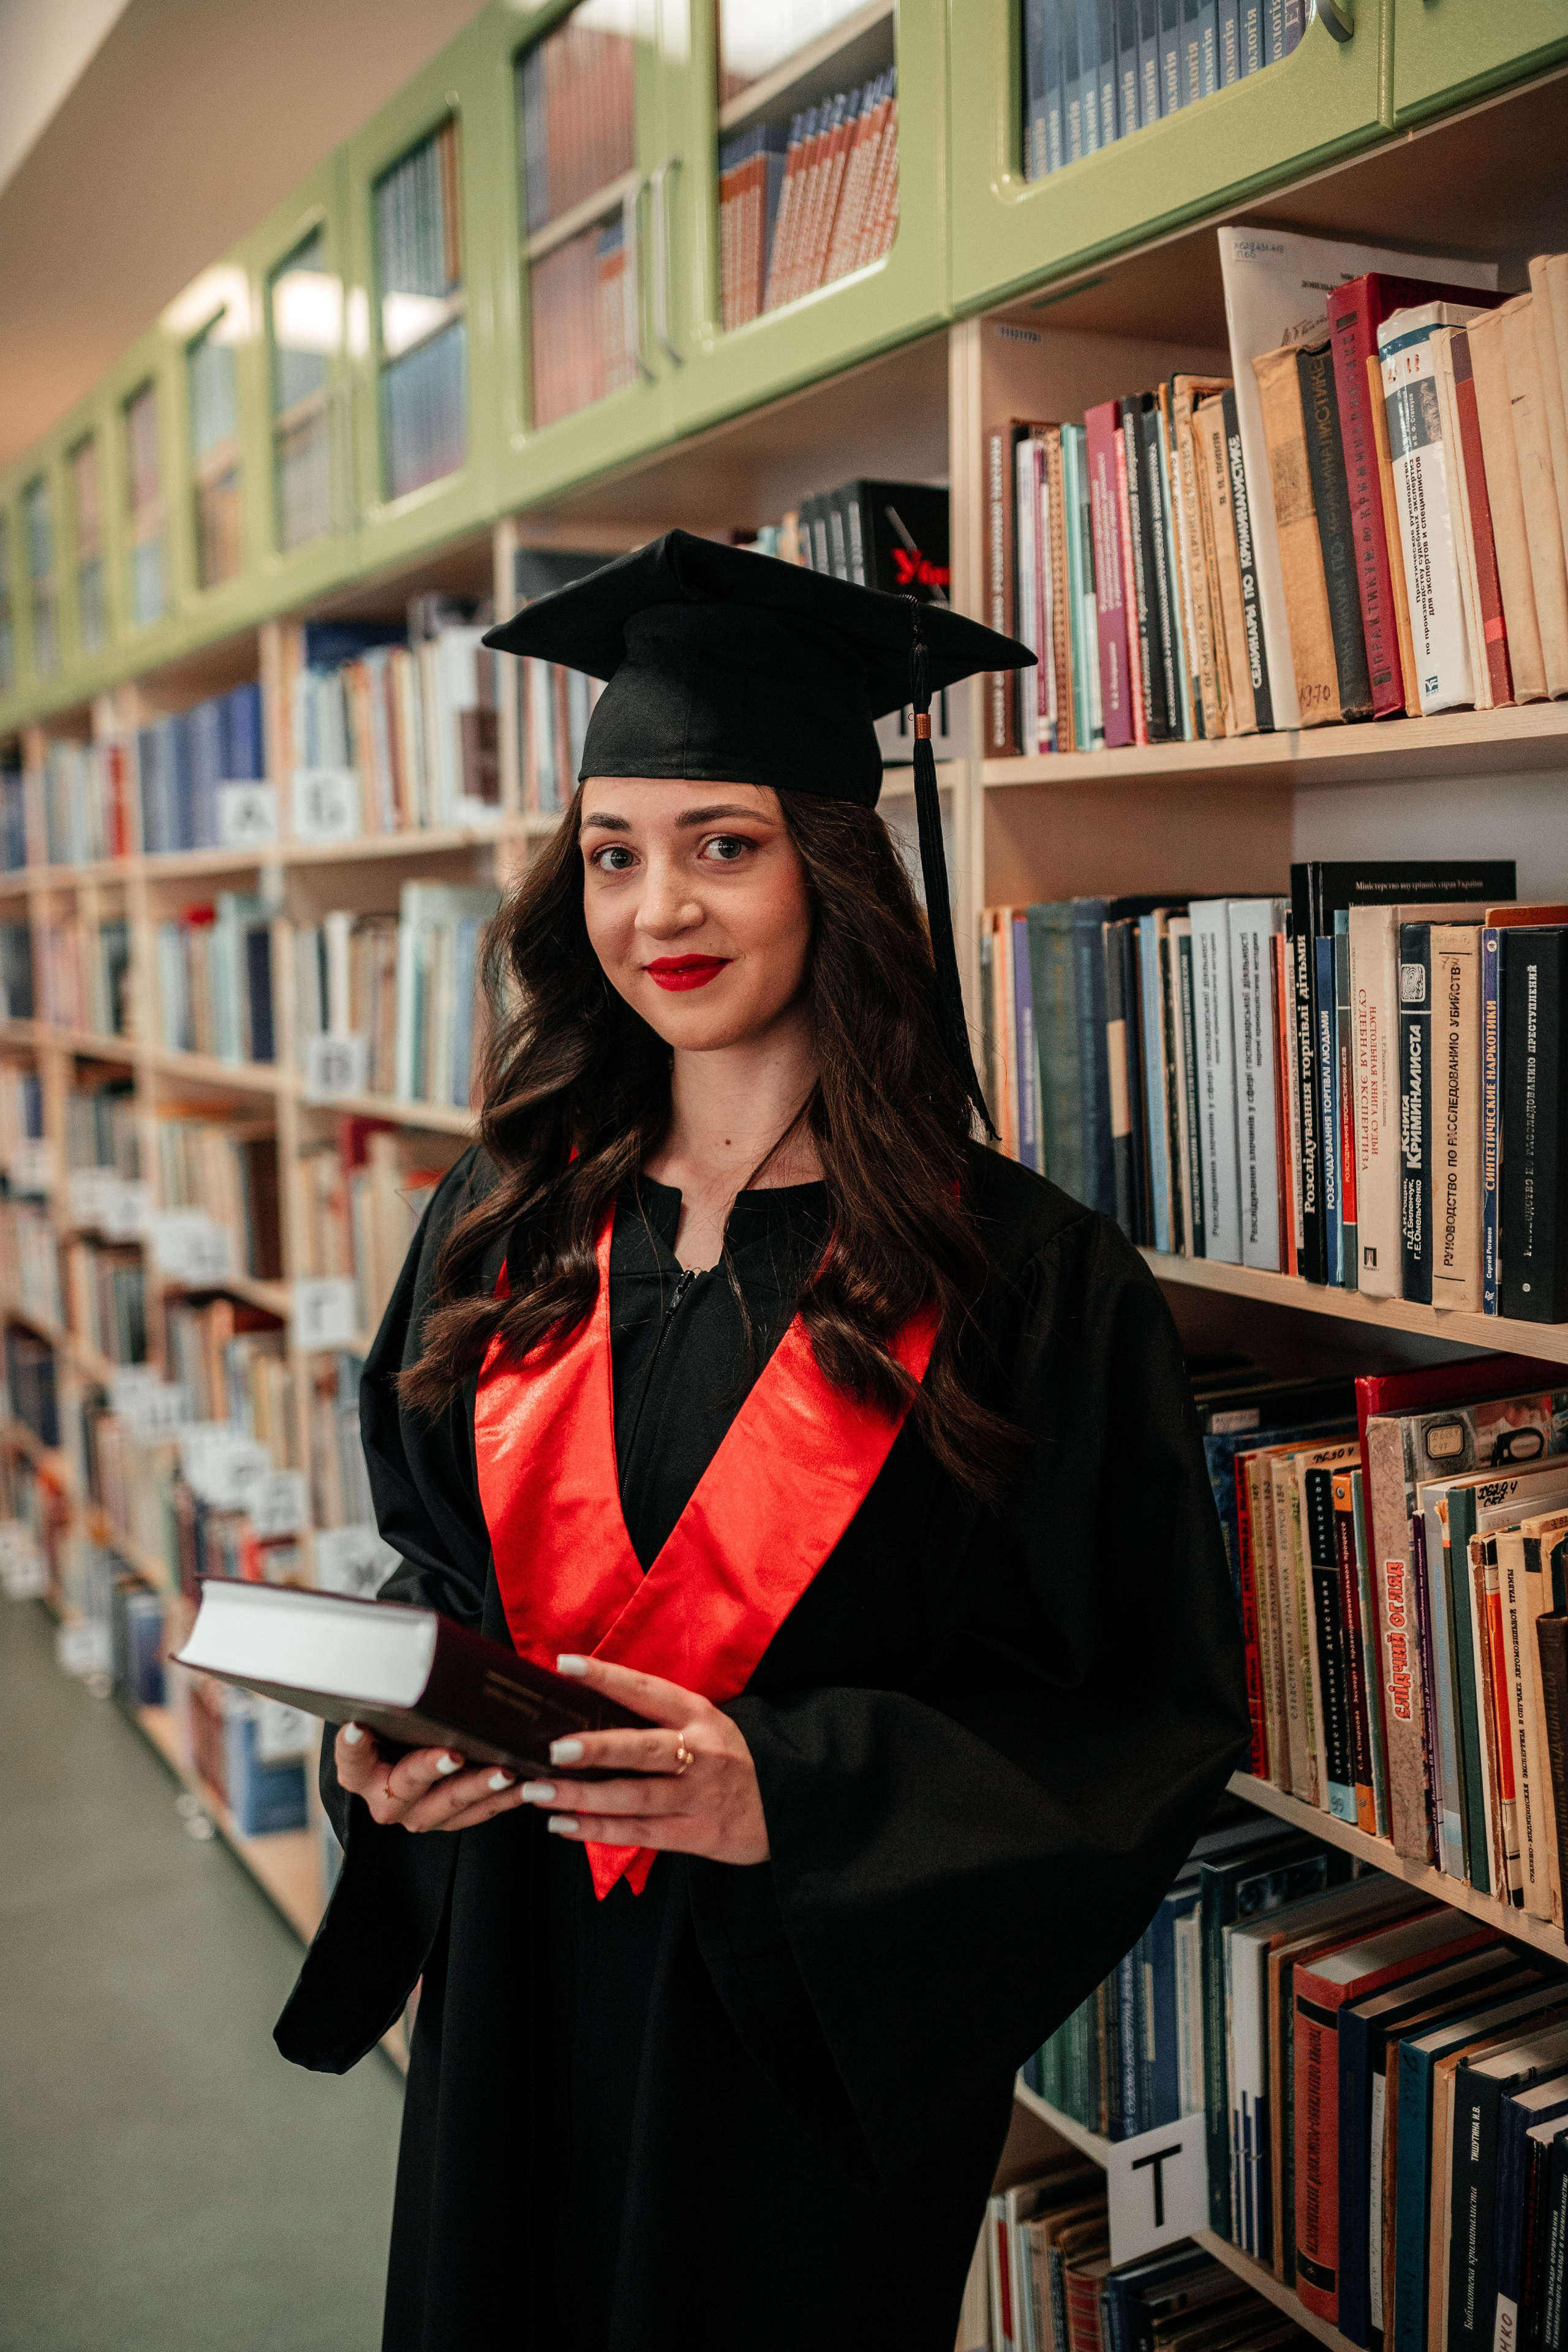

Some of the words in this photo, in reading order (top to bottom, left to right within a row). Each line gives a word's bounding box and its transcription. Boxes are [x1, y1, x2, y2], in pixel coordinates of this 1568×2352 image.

[1227, 434, 1253, 568] КРИМИНАЛИСТИКЕ
[1404, 462, 1414, 526] руководство
[1409, 459, 1419, 513] экспертиз
[1414, 456, 1426, 529] специалистов
[1410, 529, 1420, 603] Практическое
[1414, 516, 1423, 565] судебных
[1422, 541, 1433, 595] экспертов
[1242, 574, 1256, 600] ПО
[1419, 568, 1429, 640] производству
[1245, 604, 1262, 689] СЕМИНАРЫ
[1425, 643, 1431, 655] по
[1296, 934, 1310, 1000] дітьми
[1448, 966, 1461, 1028] УБИЙСТВ
[1298, 1005, 1313, 1079] торгівлі
[1321, 1010, 1331, 1064] ЛЮДЬМИ
[1359, 989, 1368, 1068] СУДЕБНАЯ
[1370, 1006, 1378, 1076] НАСТОЛЬНАЯ
[1485, 1000, 1496, 1080] НАРКОТИКИ
[1526, 965, 1538, 1054] ПРЕСТУПЛЕНИЙ
[1322, 1066, 1333, 1114] ТОРГІВЛІ
[1447, 1032, 1461, 1147] РАССЛЕДОВАНИЮ
[1303, 1082, 1317, 1214] Розслідування
[1324, 1115, 1335, 1210] РОЗСЛІДУВАННЯ
[1449, 1149, 1457, 1167] ПО
[1485, 1084, 1496, 1191] СИНТЕТИЧЕСКИЕ
[1407, 1179, 1415, 1250] П.Д.Биленчук,
[1444, 1172, 1458, 1267] РУКОВОДСТВО
[1314, 1476, 1327, 1559] PINKERTON
[1341, 1521, 1349, 1561] процессе
[1283, 1567, 1292, 1624] ПРАКТИКА
[1321, 1580, 1334, 1651] ДЕЙСТВИЯ
[1344, 1563, 1355, 1659] правоприменительном
[1386, 1561, 1405, 1627] ОГЛЯД
[1507, 1568, 1516, 1604] ТРАВМЫ
[1386, 1632, 1411, 1719] СЛІДЧИЙ
[1509, 1608, 1521, 1679] АВТОМОБИЛЬНОЙ
[1327, 1659, 1341, 1774] СЛЕДСТВЕННЫЕ
[1515, 1682, 1524, 1719] СЛУЧАЯХ
[1357, 1752, 1363, 1762] А.
[1518, 1728, 1528, 1779] ЭКСПЕРТИЗА
[1523, 1783, 1535, 1884] СУДЕБНО-МЕДИЦИНСКАЯ
[1471, 2105, 1480, 2120] И.В.
[1471, 2122, 1480, 2162] ТИШУТИНА
[1132, 2144, 1182, 2227] Т
[1558, 2174, 1568, 2241] КРИМІНАЛІСТИЦІ
[1468, 2186, 1479, 2266] криминалиста
[1464, 2267, 1476, 2331] Библиотека
[1545, 2297, 1553, 2344] ТЕОРЕТИЧНІ
[1550, 2210, 1559, 2264] ФОРМУВАННЯ
[1556, 2249, 1565, 2283] ПІДХОДУ
[1552, 2284, 1562, 2350] ТЕХНОЛОГІЧНОГО
